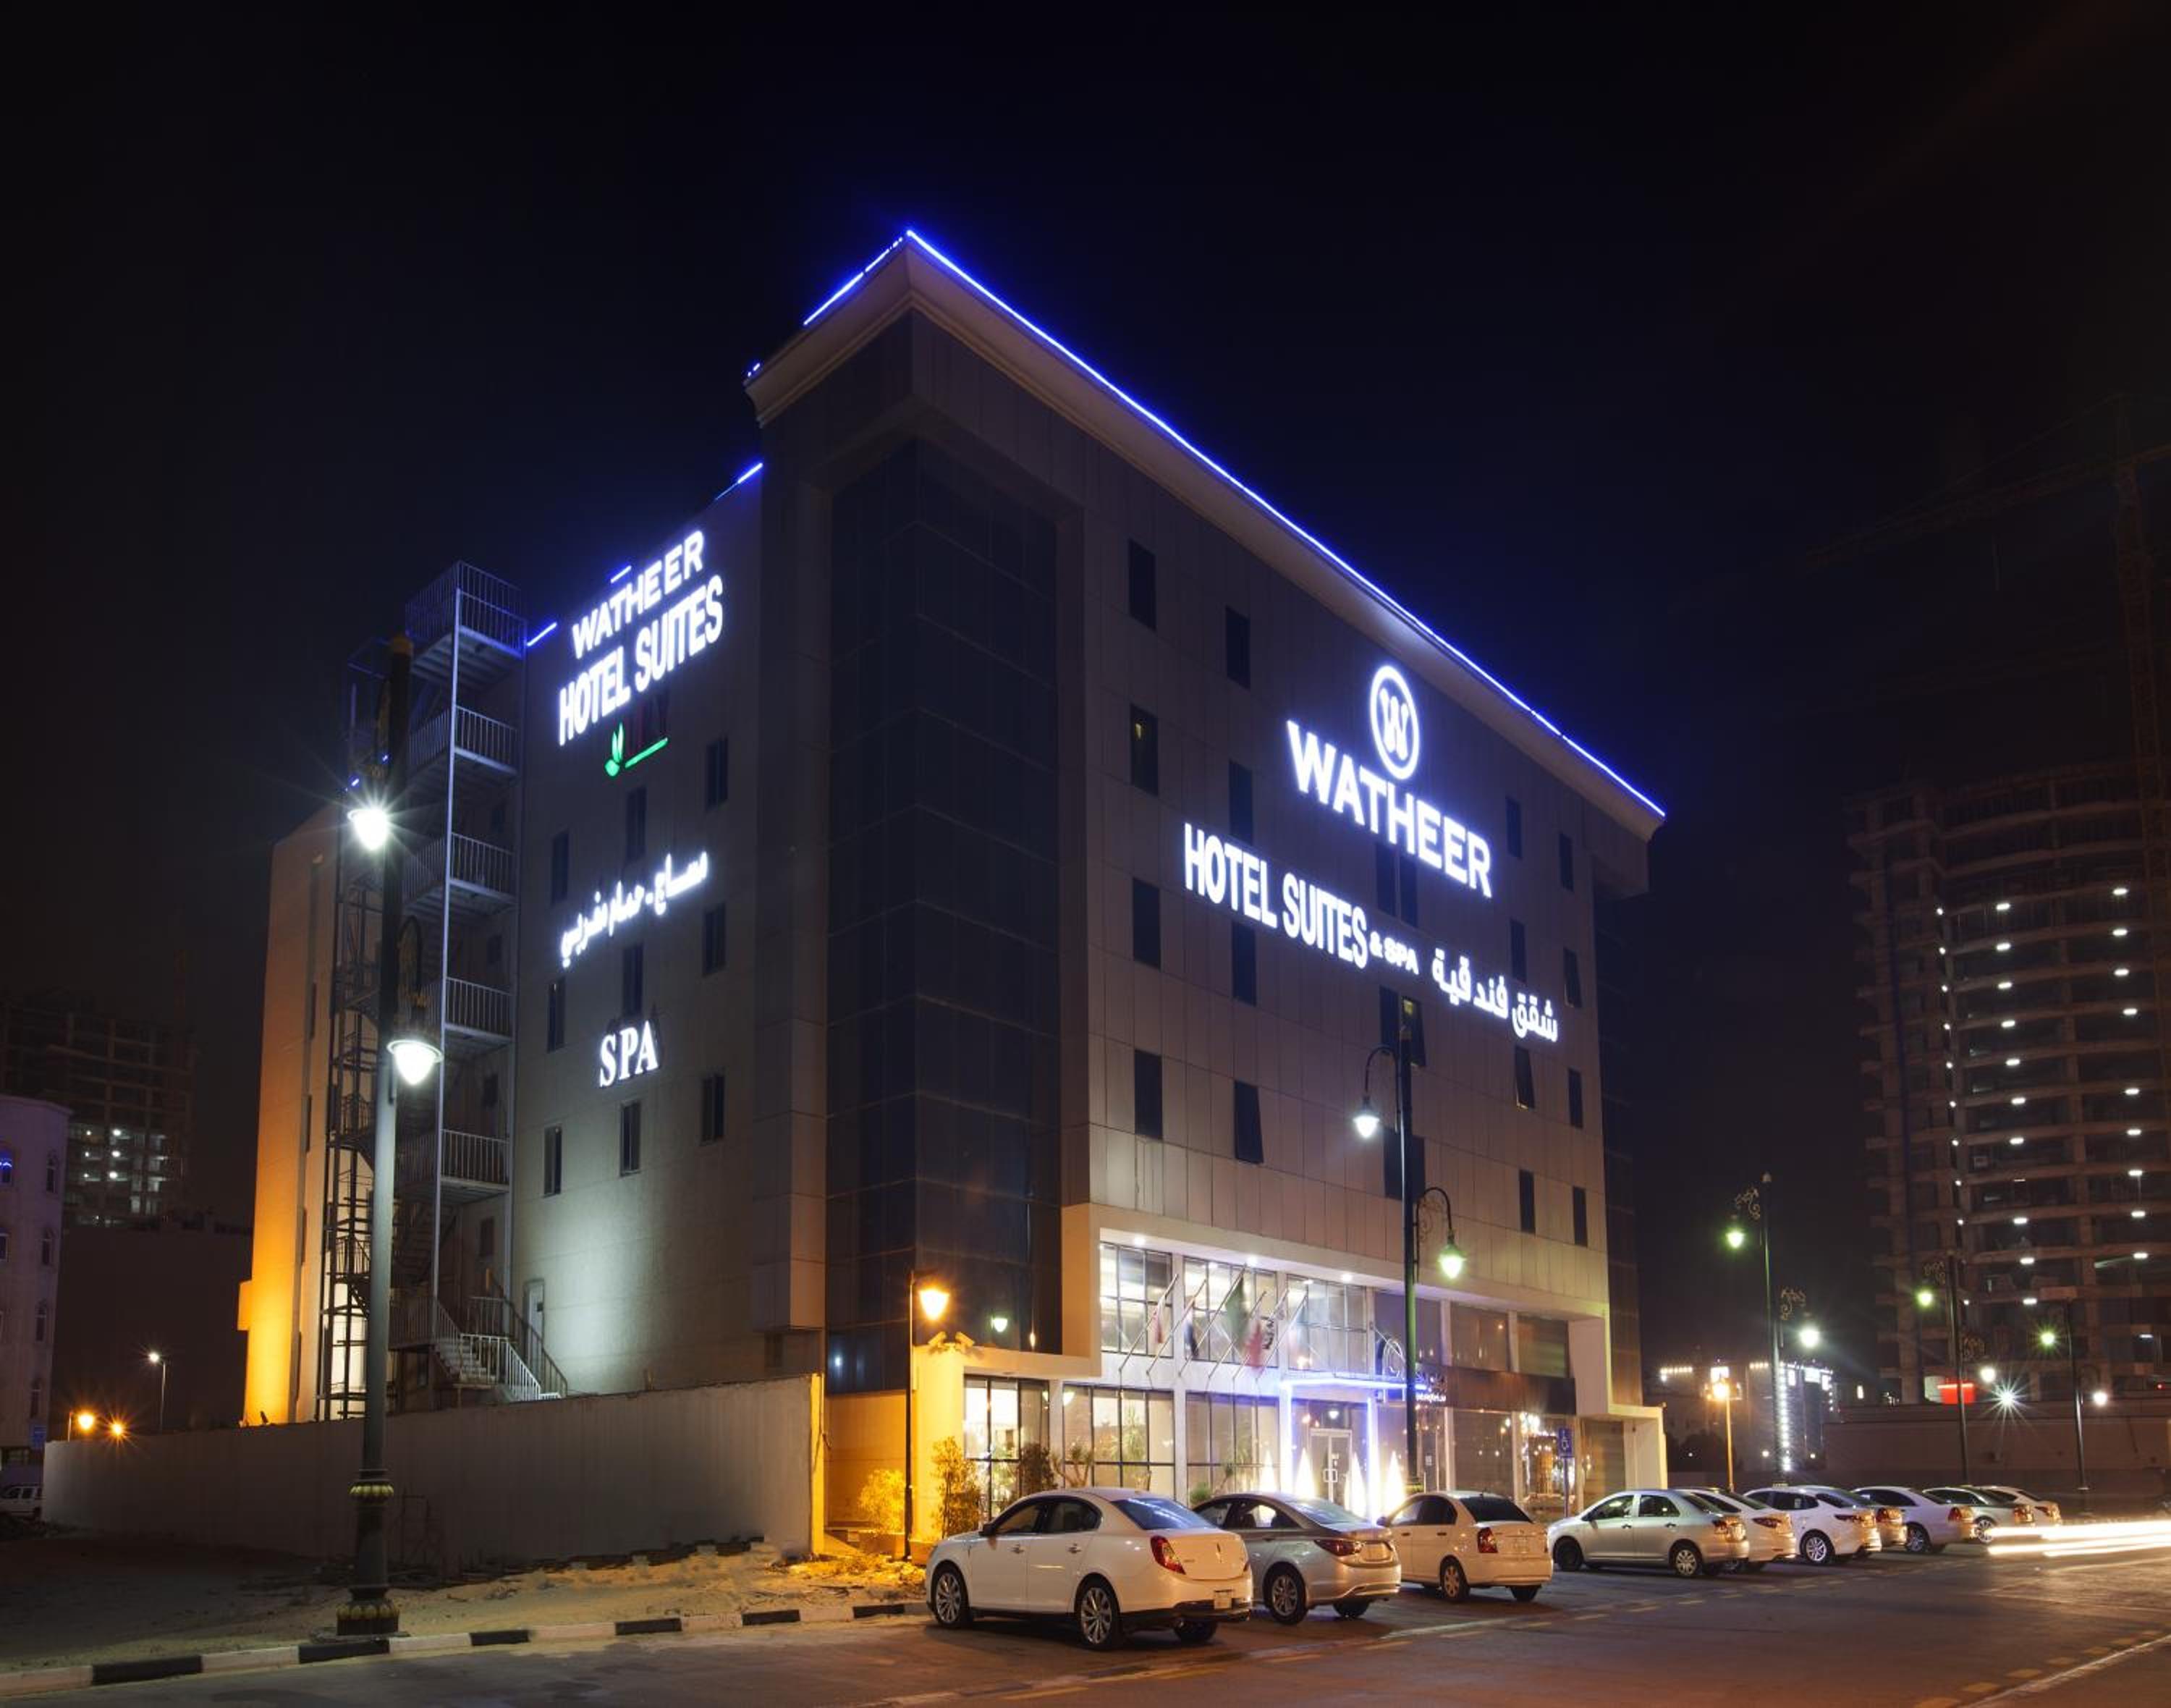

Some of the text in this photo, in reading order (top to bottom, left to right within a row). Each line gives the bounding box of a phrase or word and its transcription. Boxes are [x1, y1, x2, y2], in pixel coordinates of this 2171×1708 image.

[559, 575, 723, 746] HOTEL SUITES
[572, 530, 704, 659] WATHEER
[1286, 719, 1492, 898] WATHEER
[1185, 822, 1419, 975] HOTEL SUITES & SPA
[599, 1020, 659, 1087] SPA
[1431, 947, 1558, 1043] شقق فندقية
